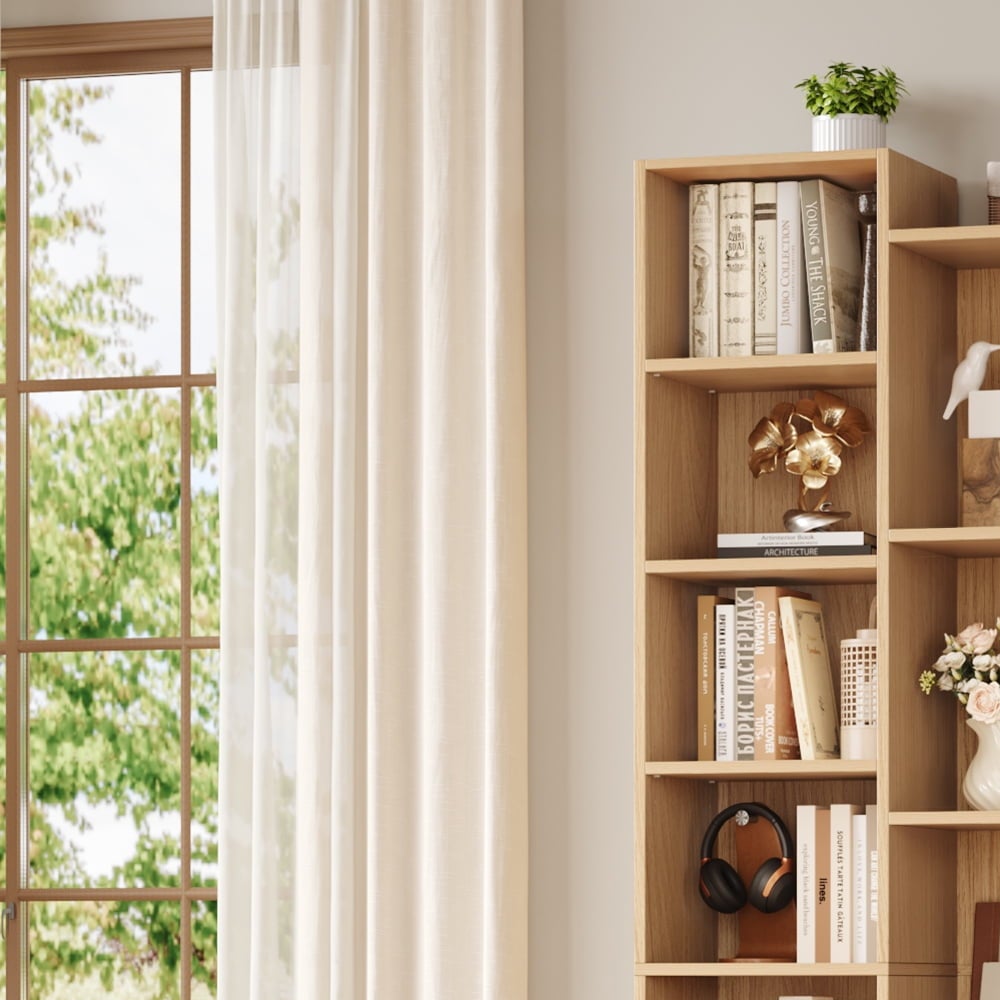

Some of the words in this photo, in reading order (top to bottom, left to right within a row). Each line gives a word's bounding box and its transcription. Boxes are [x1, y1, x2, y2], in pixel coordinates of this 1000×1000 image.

[805, 201, 820, 246] YOUNG
[779, 219, 791, 287] COLLECTION
[808, 256, 825, 283] THE
[780, 290, 792, 327] JUMBO
[811, 284, 828, 326] SHACK
[764, 548, 819, 556] ARCHITECTURE
[735, 594, 755, 697] ПАСТЕРНАК
[754, 600, 765, 655] CHAPMAN
[767, 610, 776, 644] CALLUM
[735, 700, 755, 755] БОРИС
[765, 704, 775, 727] BOOK
[765, 728, 775, 754] COVER
[819, 877, 828, 905] lines.
